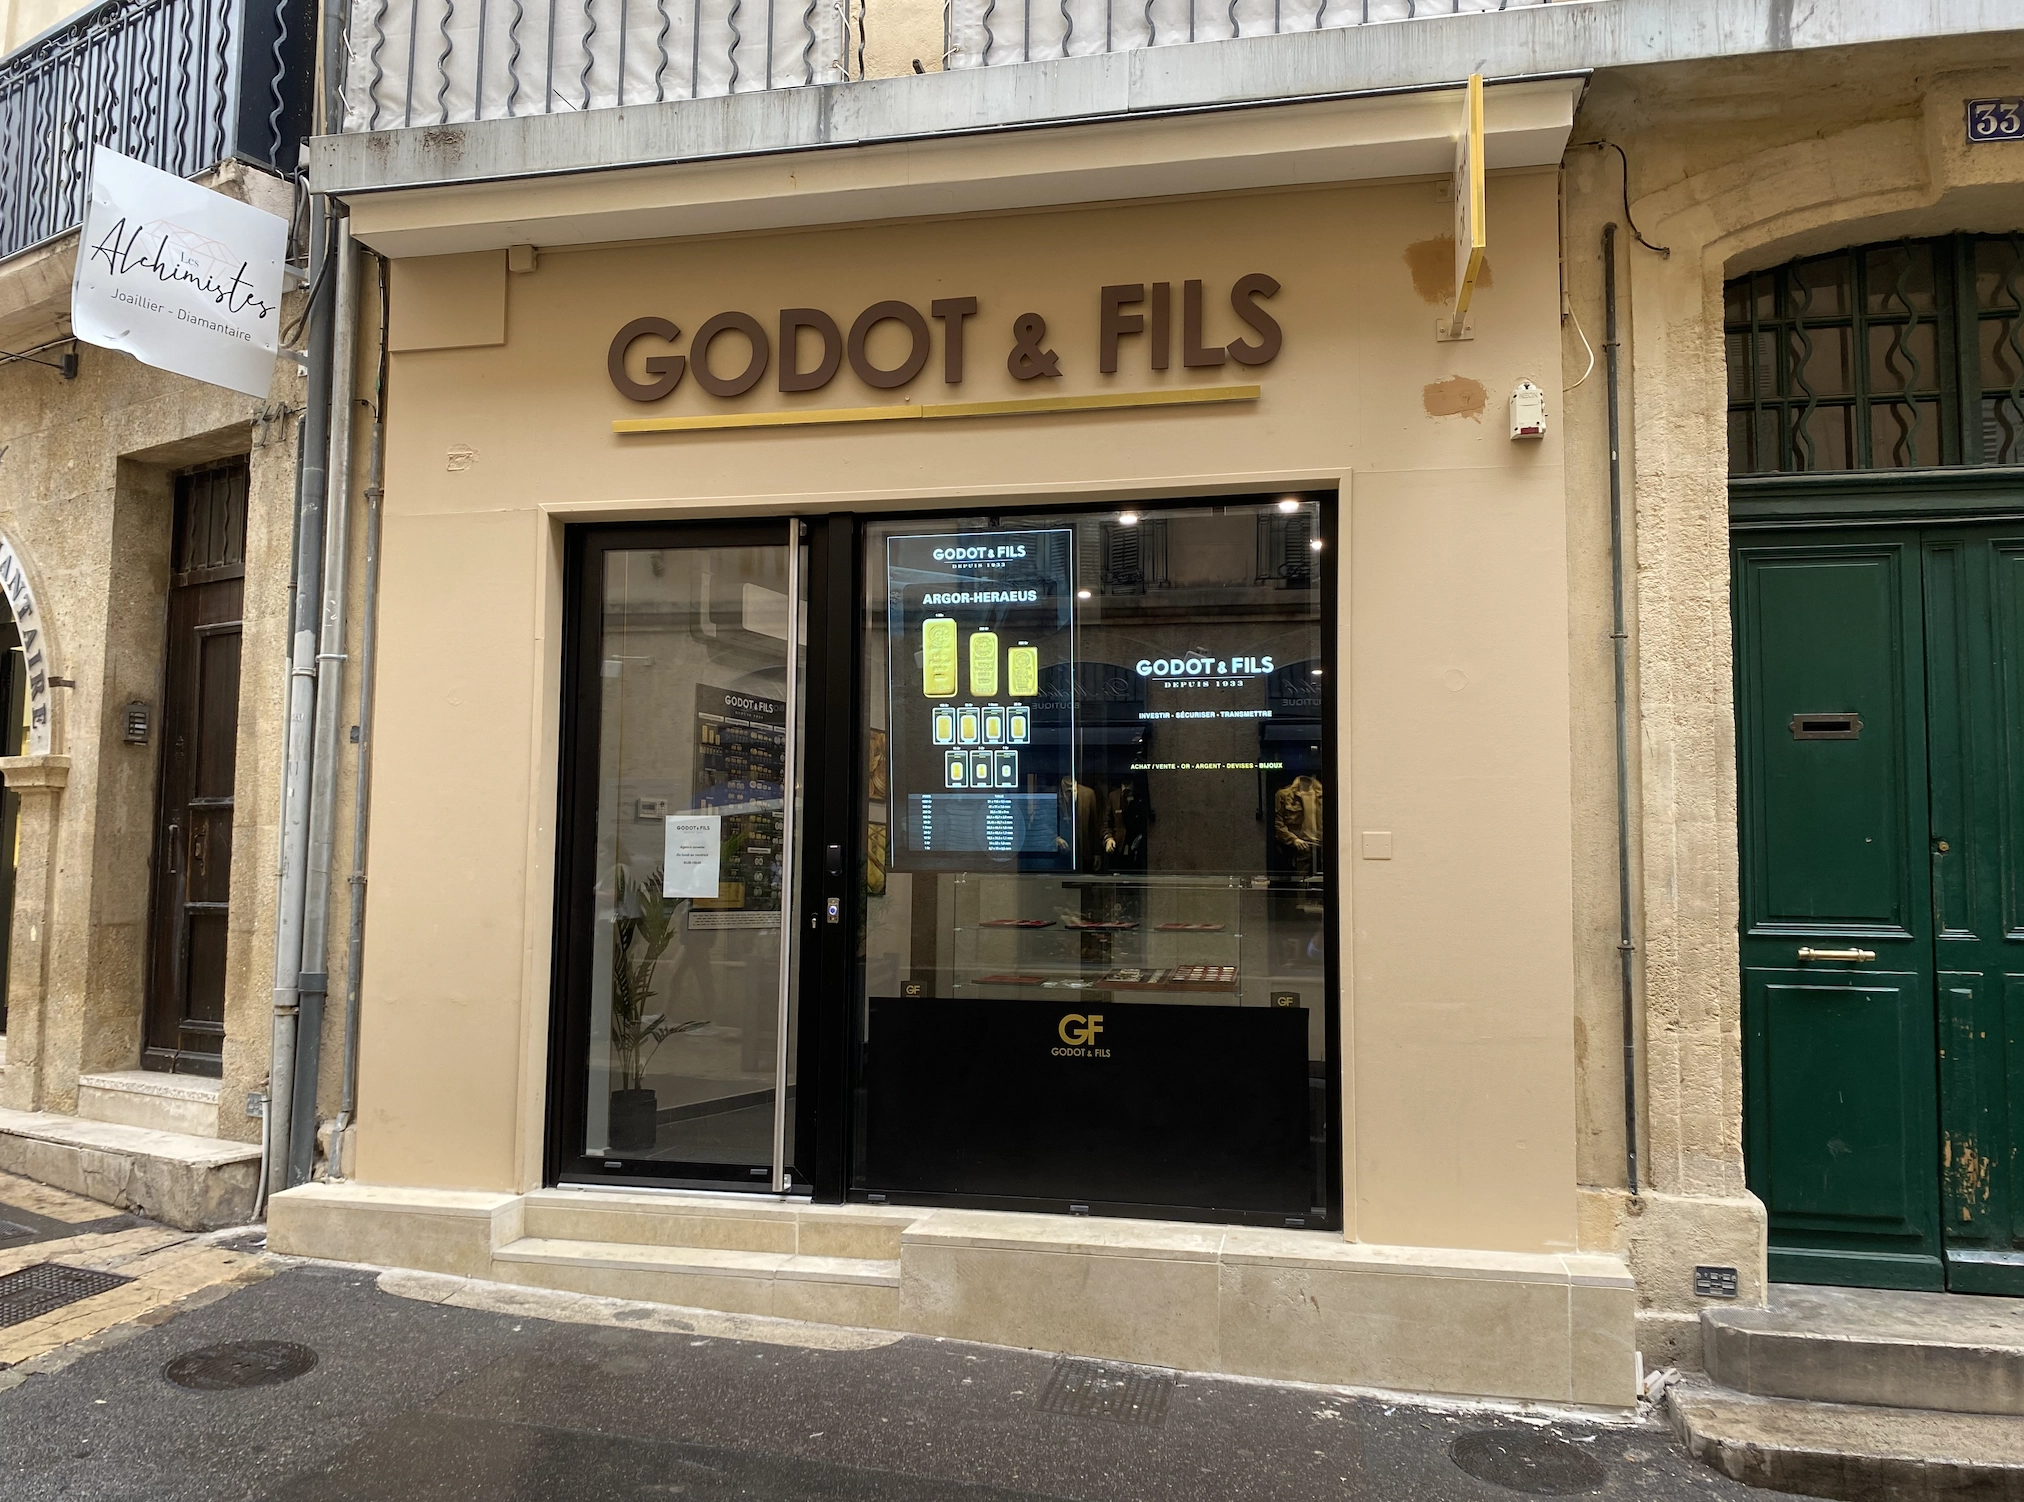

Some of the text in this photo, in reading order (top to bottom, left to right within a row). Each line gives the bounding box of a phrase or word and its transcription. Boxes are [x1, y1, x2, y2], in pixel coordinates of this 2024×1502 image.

[1974, 103, 2021, 135] 33
[91, 217, 276, 319] Alchimistes
[180, 251, 200, 268] Les
[111, 288, 165, 313] Joaillier
[178, 308, 252, 342] Diamantaire
[608, 272, 1283, 402] GODOT & FILS
[932, 544, 1027, 561] GODOT & FILS
[922, 589, 1038, 605] ARGOR-HERAEUS
[1135, 655, 1275, 677] GODOT & FILS
[1216, 680, 1244, 688] 1933
[724, 694, 754, 710] GODOT
[758, 701, 774, 714] FILS
[1138, 711, 1171, 719] INVESTIR
[1175, 710, 1216, 719] SÉCURISER
[1220, 710, 1273, 718] TRANSMETTRE
[905, 984, 921, 995] GF
[1277, 996, 1294, 1007] GF
[1058, 1013, 1104, 1046] GF
[1050, 1047, 1086, 1057] GODOT
[1094, 1048, 1111, 1058] FILS
